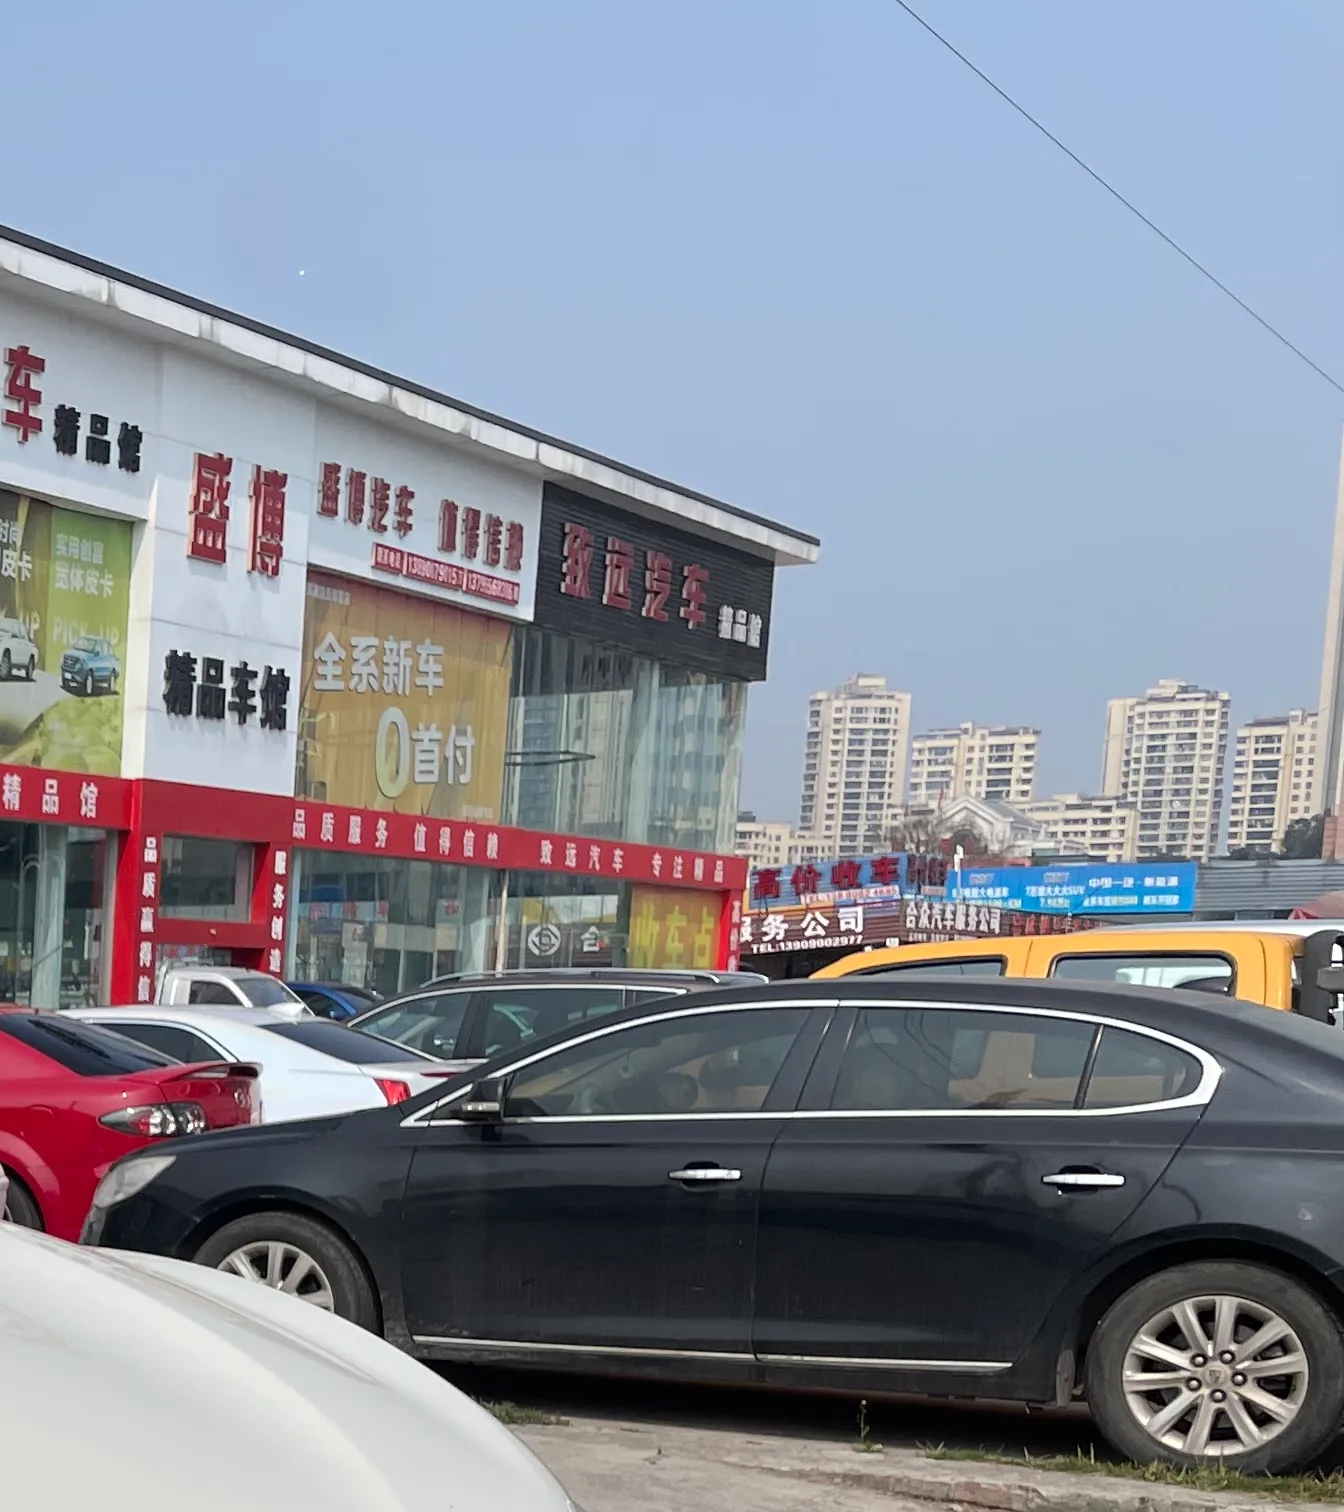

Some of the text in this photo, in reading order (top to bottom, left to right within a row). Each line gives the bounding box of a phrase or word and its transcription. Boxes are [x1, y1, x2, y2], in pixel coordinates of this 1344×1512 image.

[187, 452, 289, 578] 盛博
[560, 522, 709, 630] 致远汽车
[162, 649, 291, 731] 精品车馆
[312, 631, 445, 697] 全系新车
[753, 856, 901, 899] 高价收车
